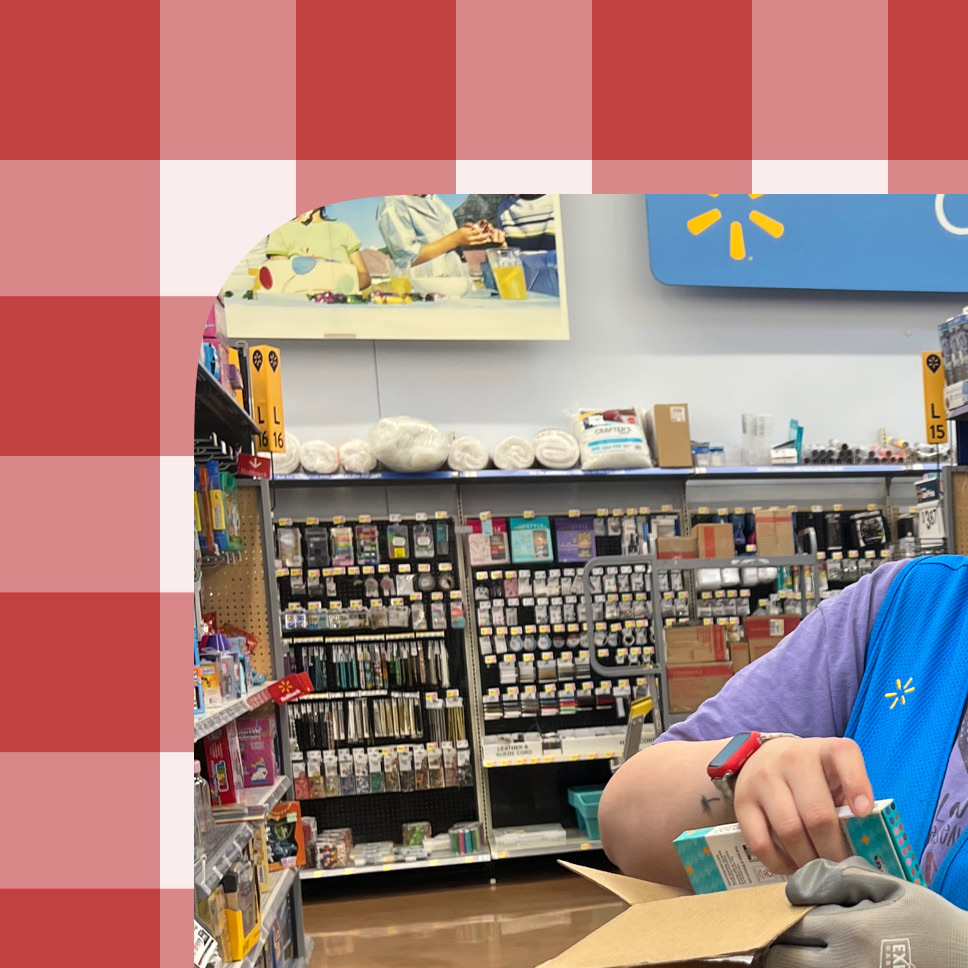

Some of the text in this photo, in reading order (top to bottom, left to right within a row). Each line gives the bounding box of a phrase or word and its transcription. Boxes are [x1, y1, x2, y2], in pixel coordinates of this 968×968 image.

[273, 406, 280, 425] L
[931, 403, 940, 419] L
[929, 424, 945, 439] 15
[273, 432, 284, 449] 16
